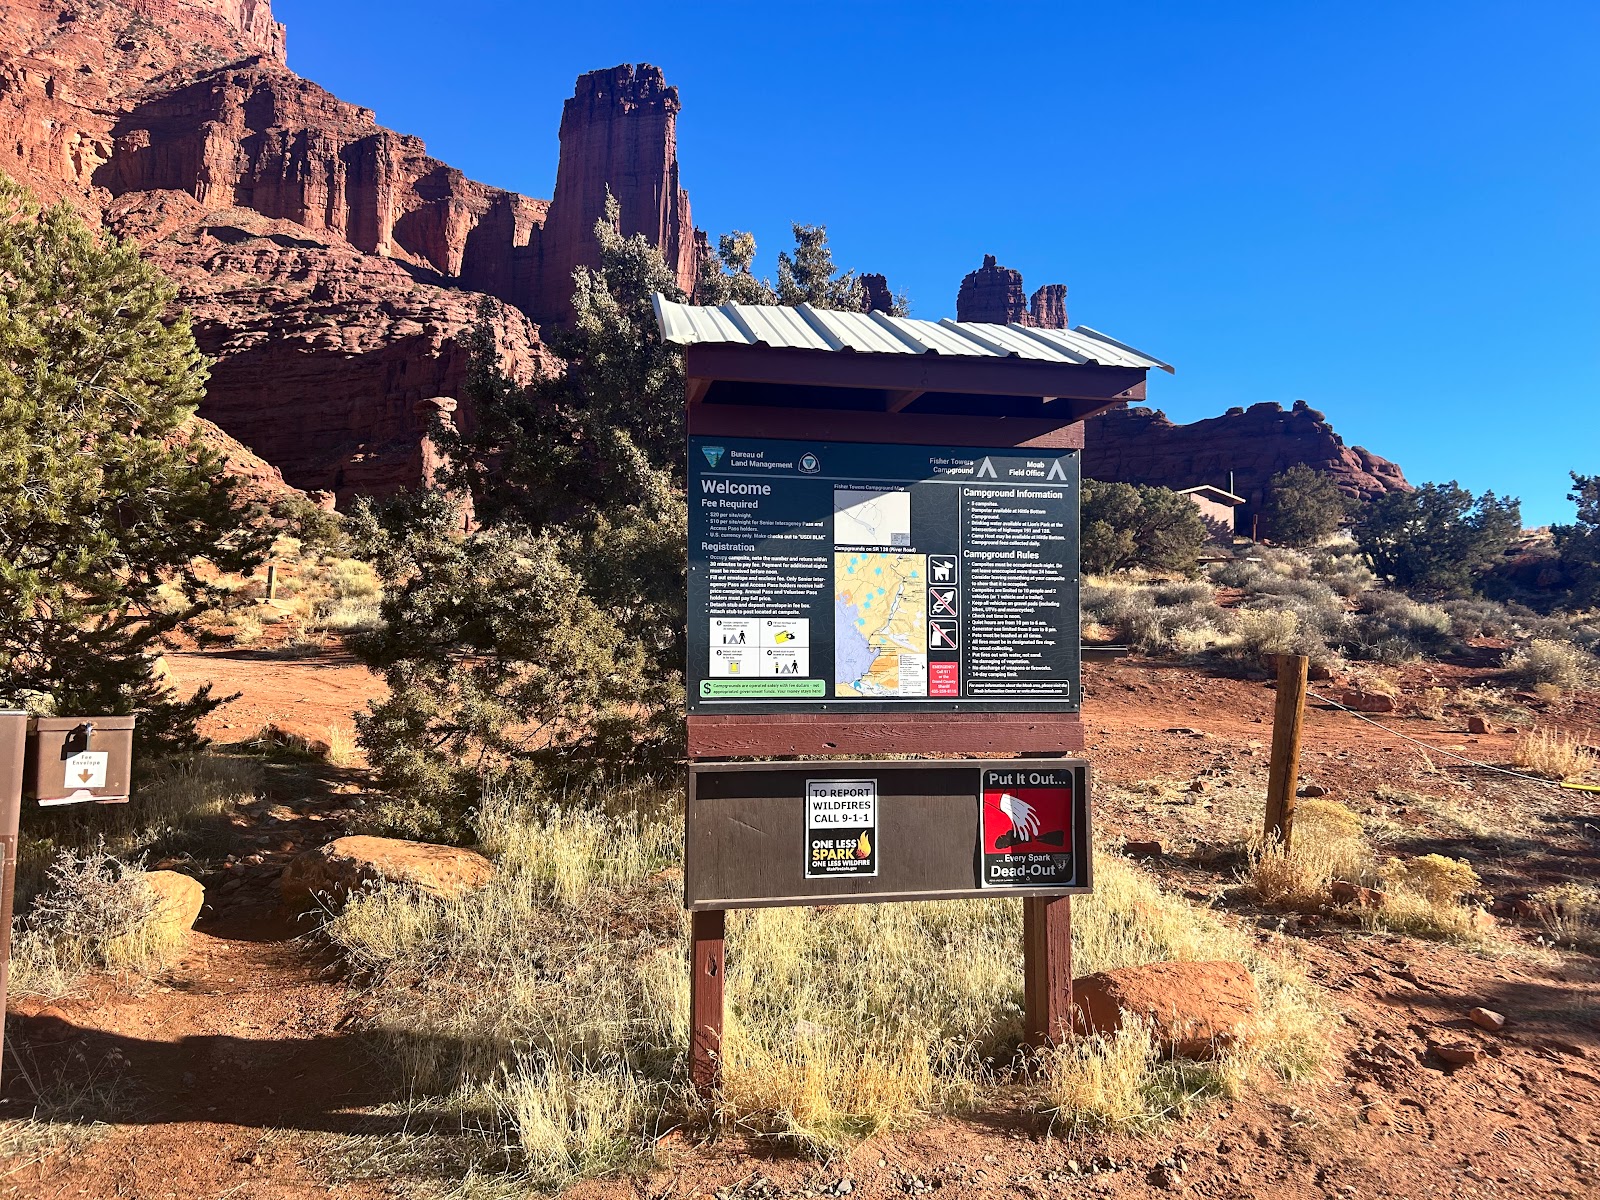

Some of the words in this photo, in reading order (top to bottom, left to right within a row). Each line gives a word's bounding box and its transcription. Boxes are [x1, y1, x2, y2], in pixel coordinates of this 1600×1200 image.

[750, 461, 793, 469] Management
[701, 480, 771, 495] Welcome
[964, 488, 1014, 498] Campground
[1017, 488, 1062, 499] Information
[701, 499, 717, 507] Fee
[720, 500, 758, 509] Required
[702, 542, 754, 552] Registration
[964, 550, 1015, 559] Campground
[1017, 551, 1039, 559] Rules
[989, 773, 1012, 784] Put
[1017, 773, 1025, 784] It
[1029, 773, 1066, 784] Out...
[813, 789, 826, 797] TO
[831, 789, 870, 797] REPORT
[813, 801, 870, 810] WILDFIRES
[815, 814, 839, 822] CALL
[842, 814, 869, 822] 9-1-1
[812, 840, 833, 848] ONE
[836, 839, 856, 848] LESS
[812, 849, 855, 860] SPARK
[1005, 854, 1026, 863] Every
[1028, 854, 1050, 863] Spark
[991, 864, 1055, 877] Dead-Out
